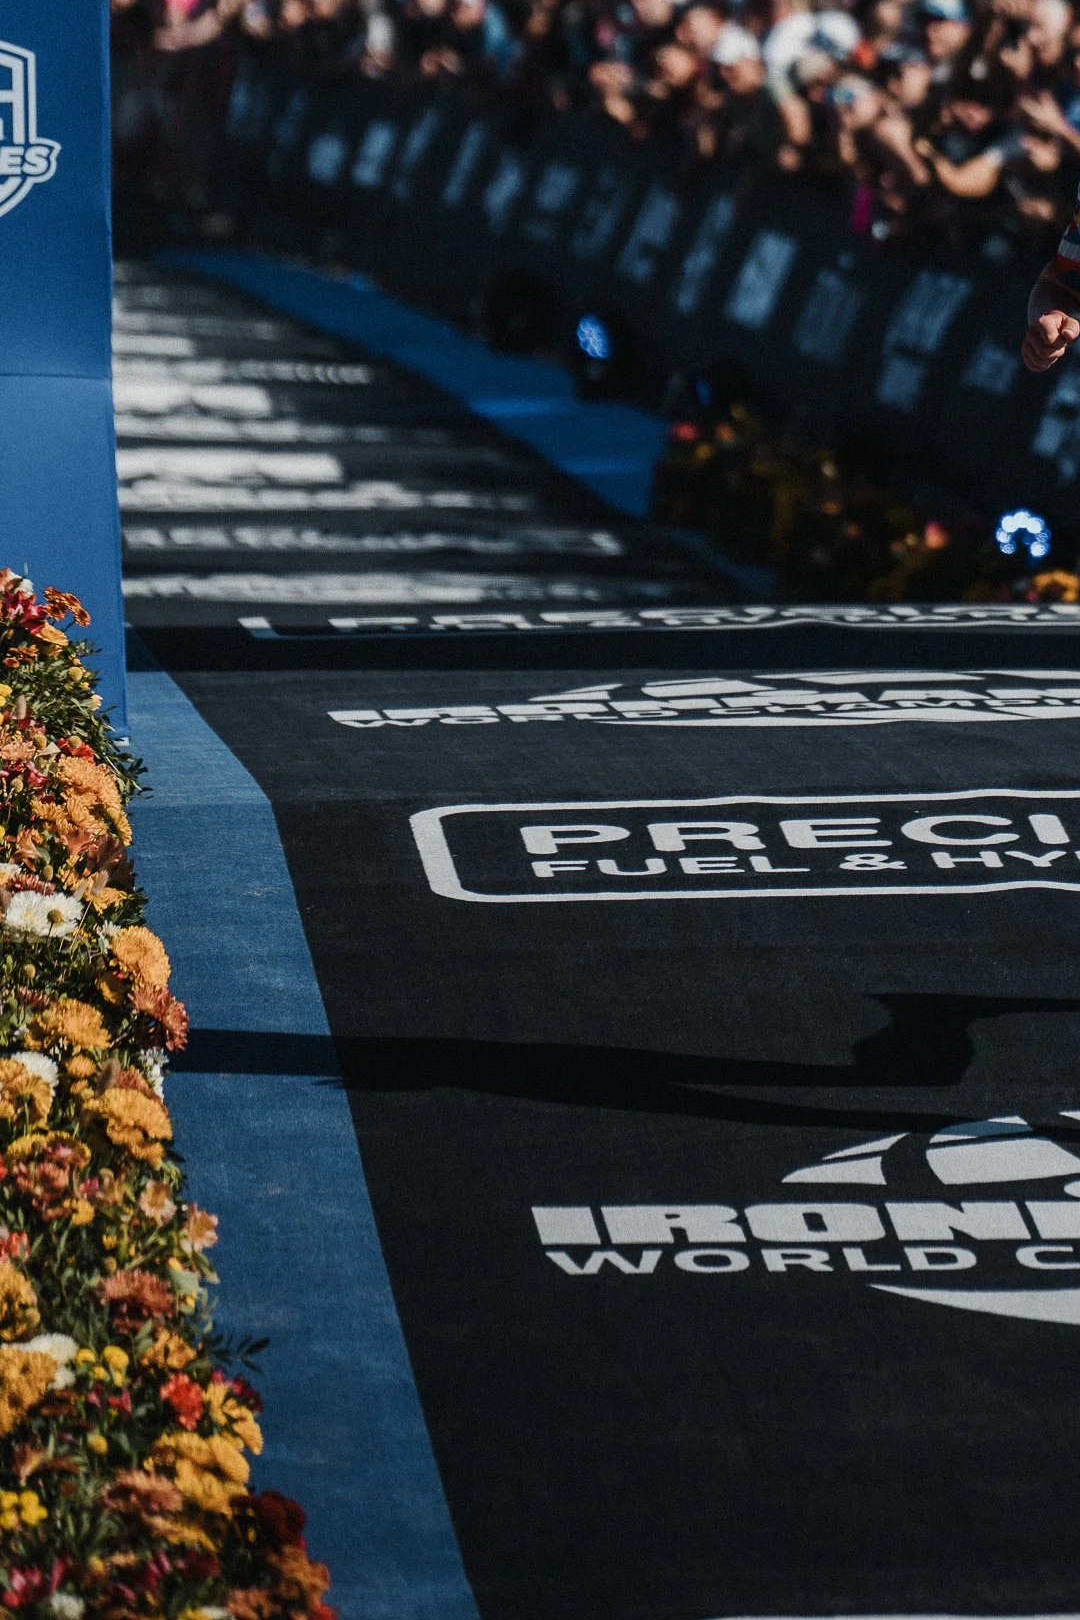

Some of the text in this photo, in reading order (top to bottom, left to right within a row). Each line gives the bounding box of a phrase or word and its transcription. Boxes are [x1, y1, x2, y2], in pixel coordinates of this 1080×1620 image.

[338, 710, 679, 728] WORLD
[530, 855, 811, 878] FUEL
[839, 853, 907, 871] &
[545, 1246, 978, 1276] WORLD
